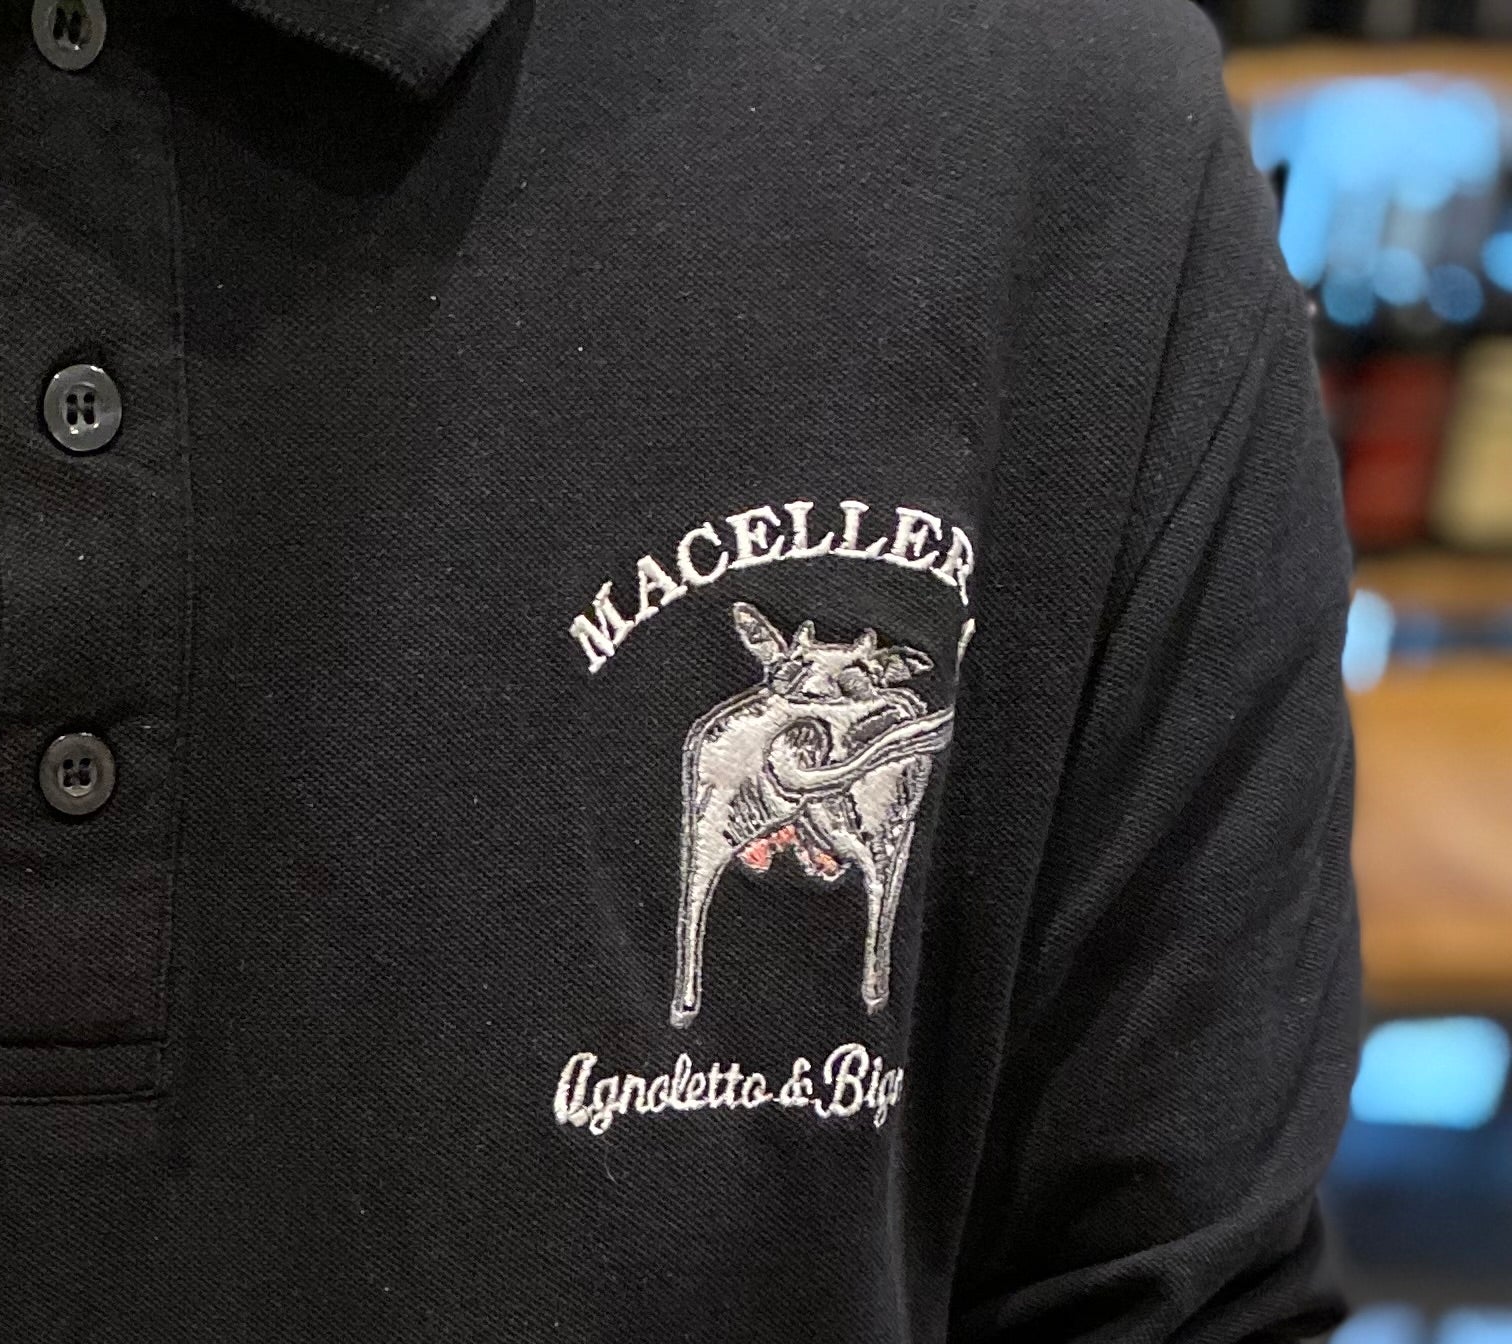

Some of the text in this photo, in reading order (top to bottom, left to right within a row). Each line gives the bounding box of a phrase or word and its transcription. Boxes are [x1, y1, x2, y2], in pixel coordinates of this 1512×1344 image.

[568, 499, 976, 673] MACELLER
[553, 1052, 772, 1135] Agnoletto
[774, 1056, 814, 1108] &
